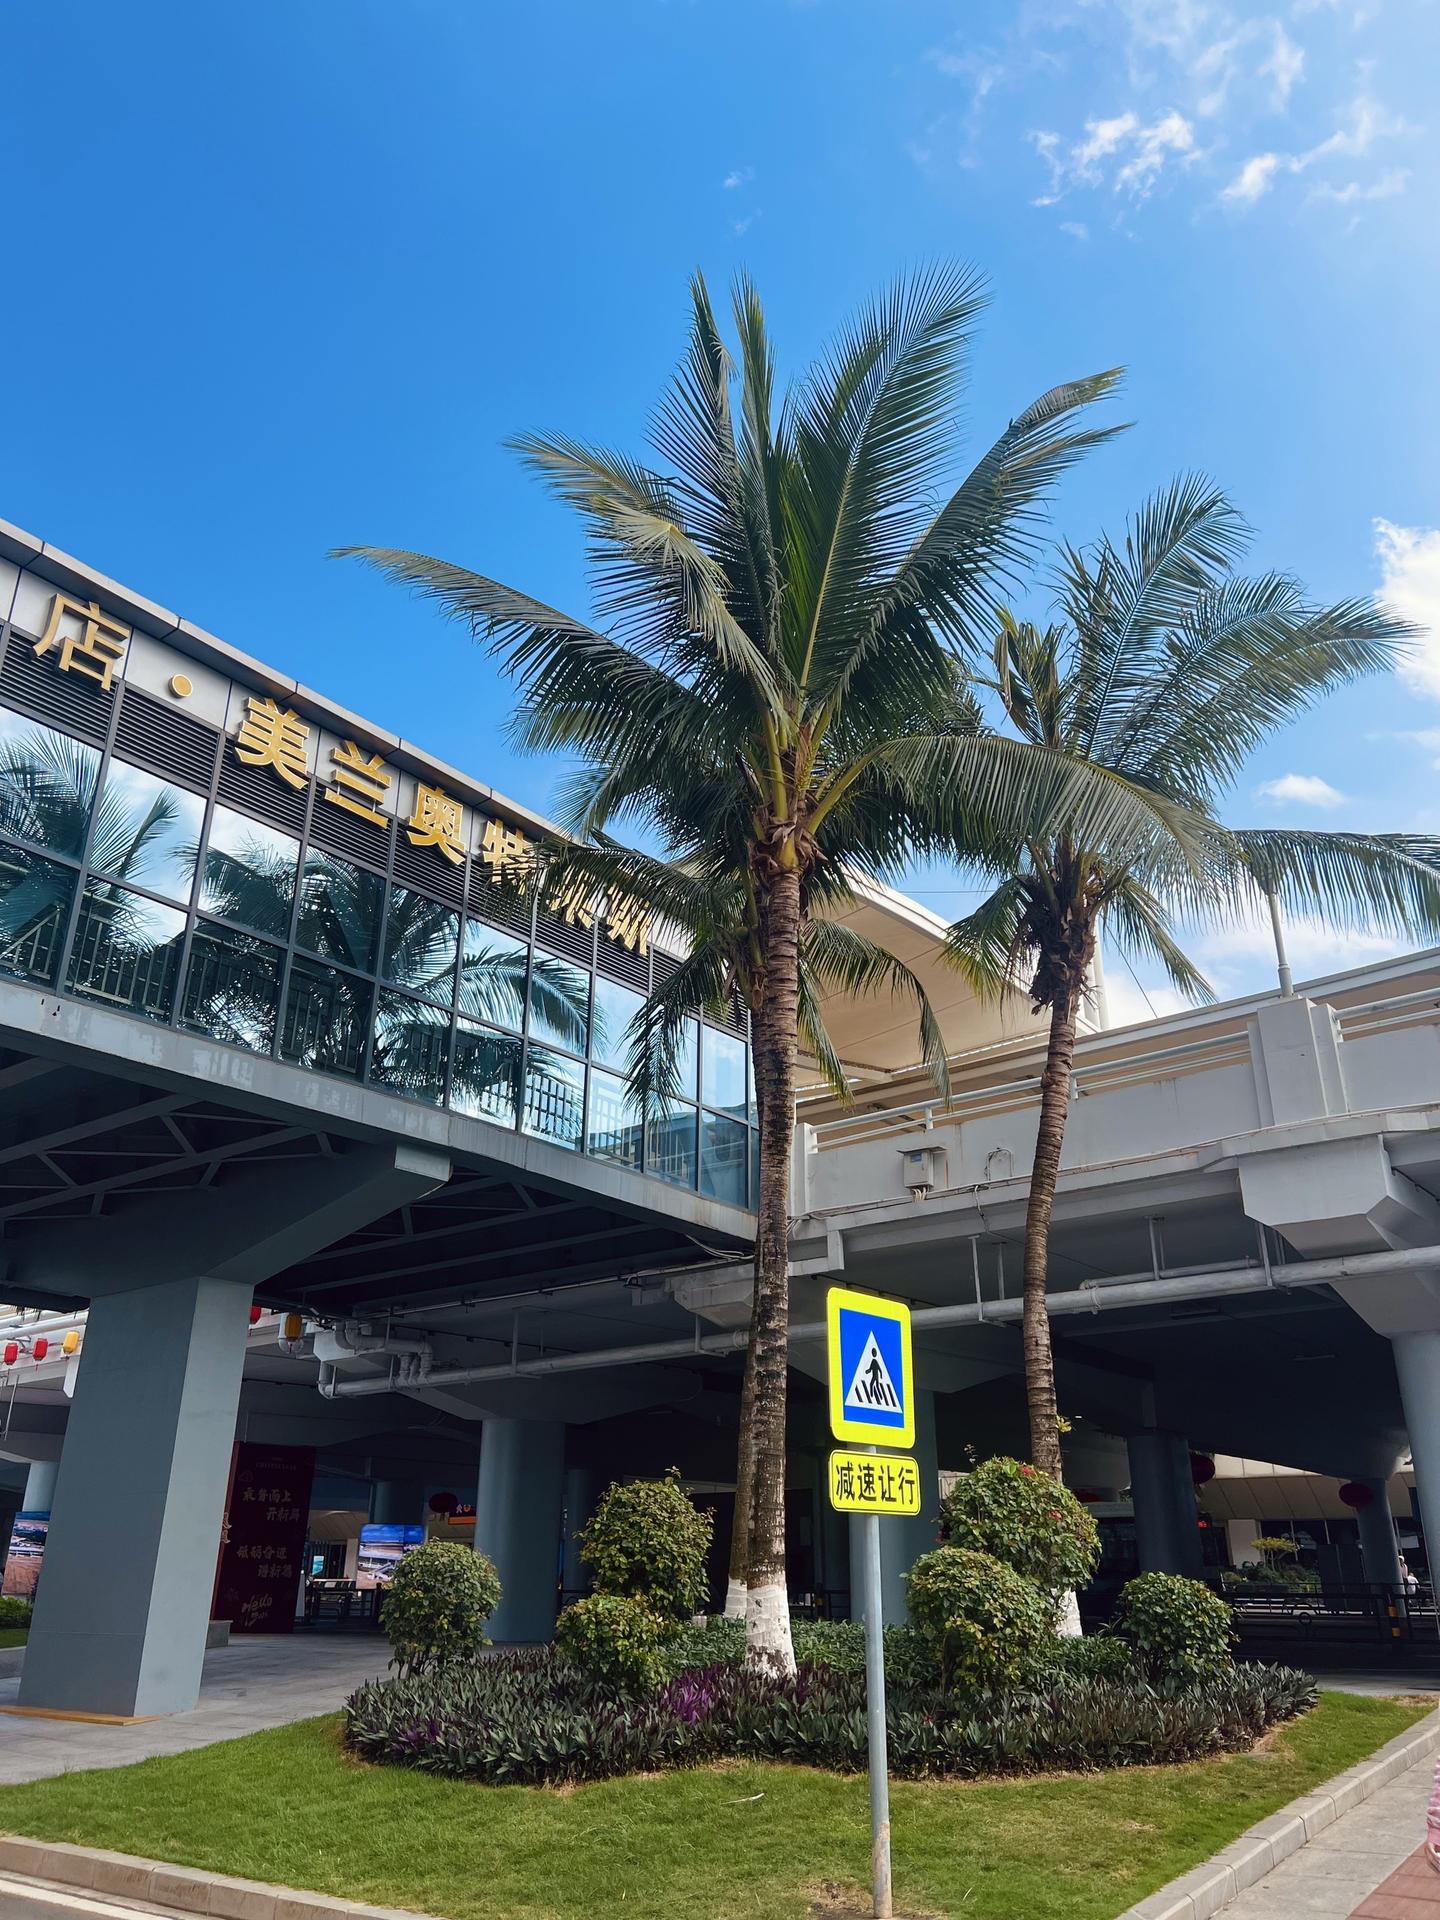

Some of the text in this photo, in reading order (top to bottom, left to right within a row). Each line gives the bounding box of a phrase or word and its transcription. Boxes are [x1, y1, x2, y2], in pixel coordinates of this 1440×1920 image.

[33, 594, 654, 957] 店·美兰奥特斯
[835, 1461, 916, 1505] 减速让行
